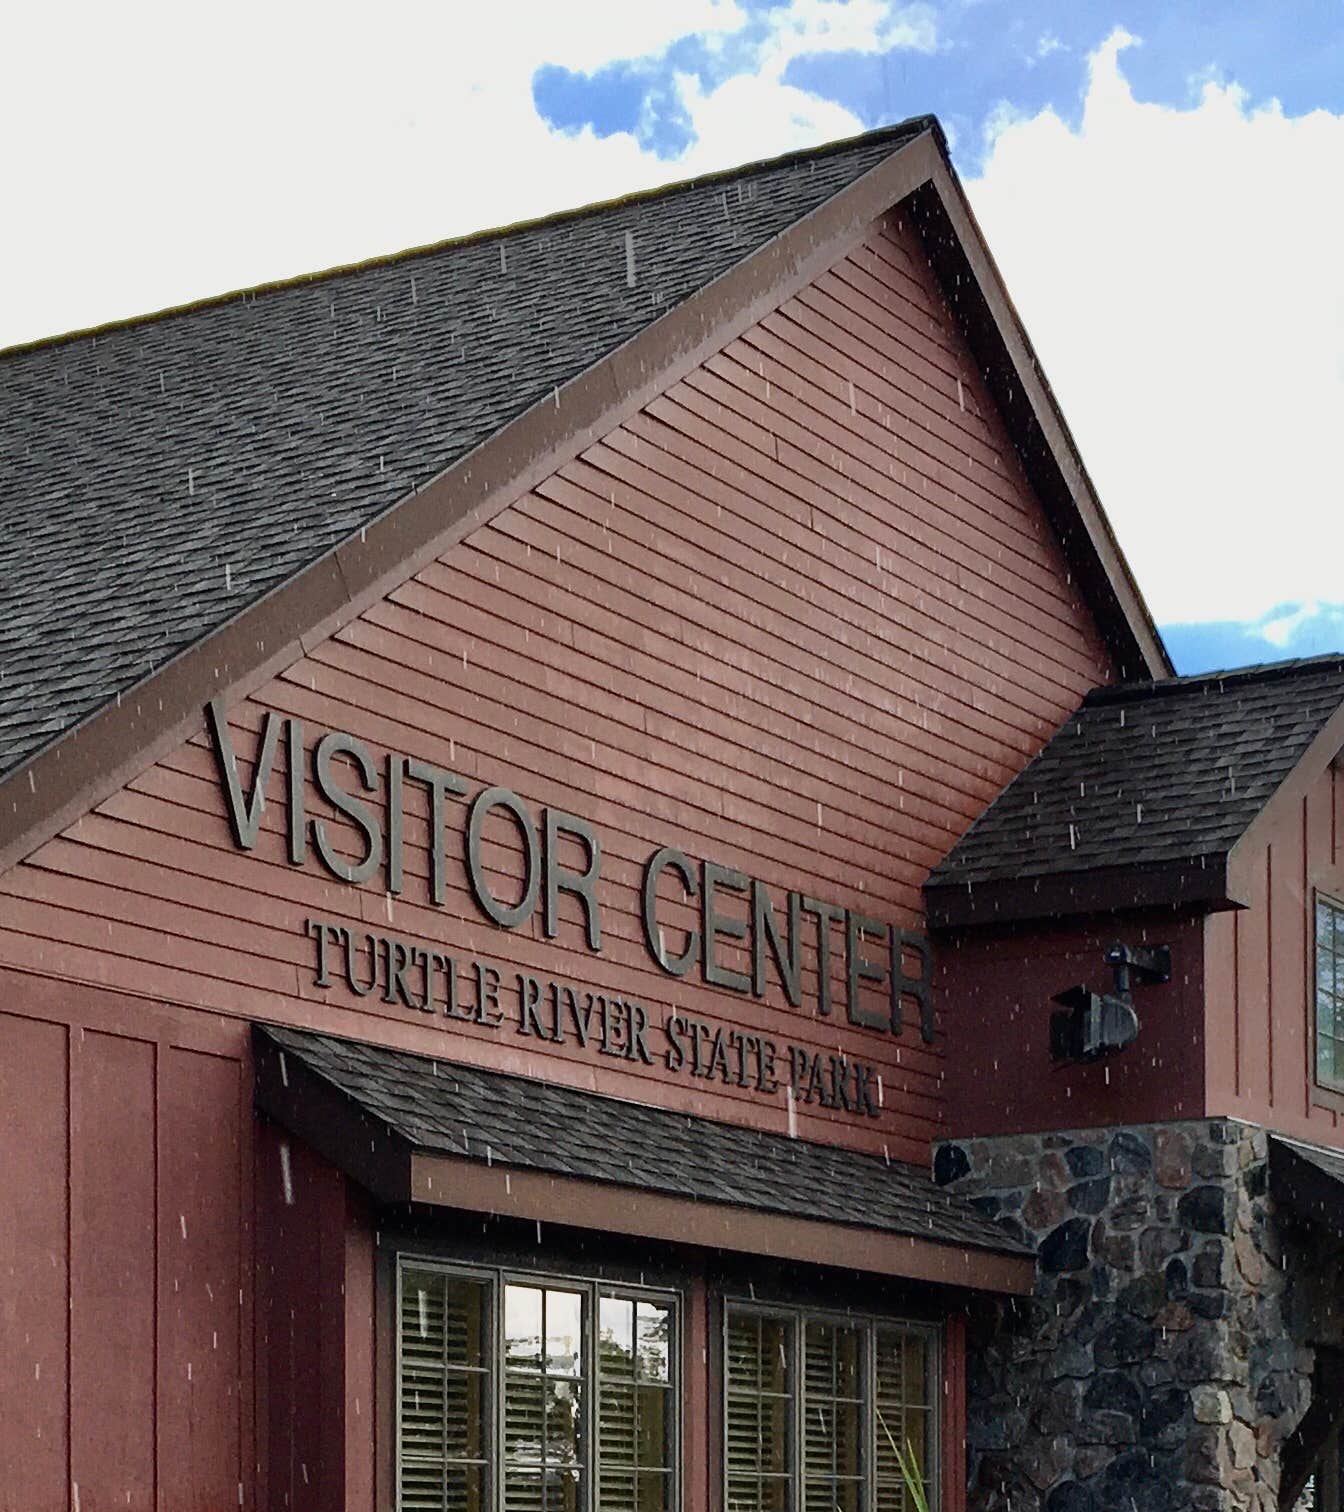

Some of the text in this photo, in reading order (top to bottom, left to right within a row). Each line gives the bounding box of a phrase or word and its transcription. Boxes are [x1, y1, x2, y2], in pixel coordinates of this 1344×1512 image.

[204, 702, 936, 1044] VISITOR CENTER
[306, 918, 880, 1118] TURTLE RIVER STATE PARK
